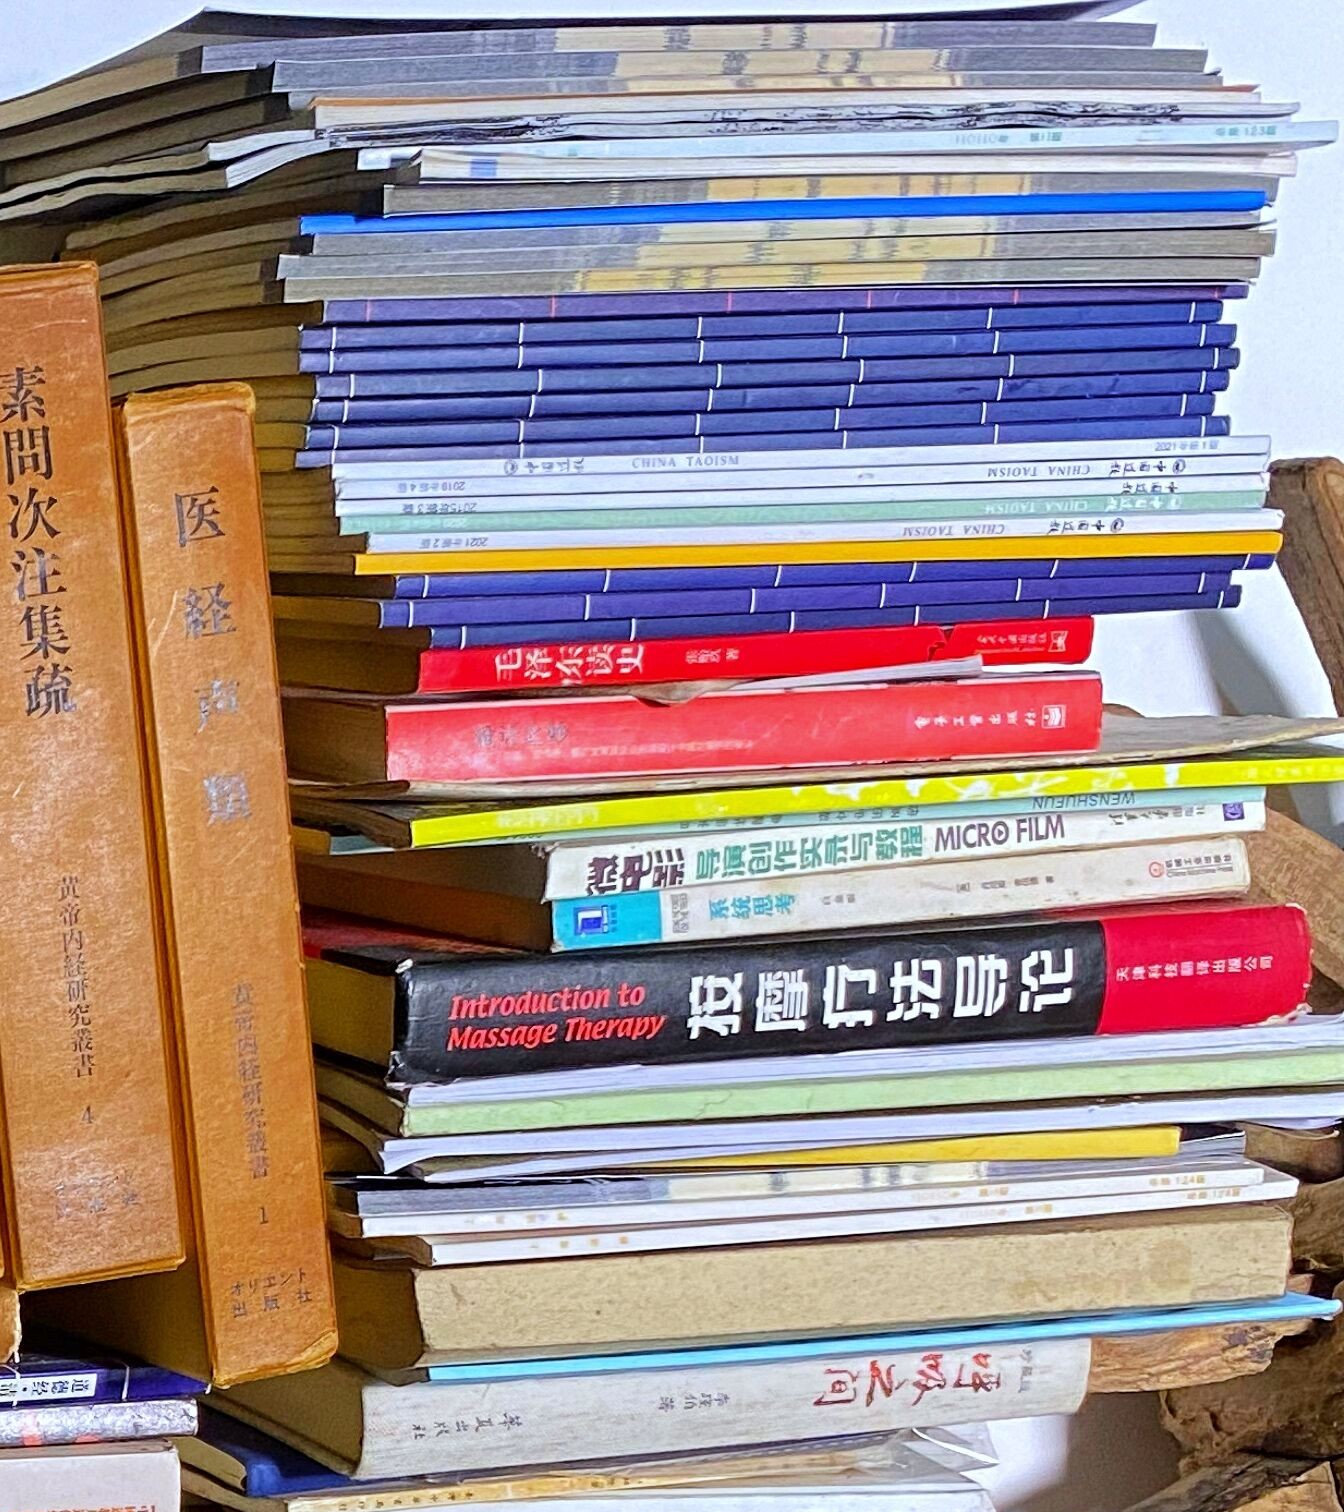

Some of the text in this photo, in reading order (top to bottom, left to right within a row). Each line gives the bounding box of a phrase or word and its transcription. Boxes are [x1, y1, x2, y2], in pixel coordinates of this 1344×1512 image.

[935, 824, 1007, 850] MICRO
[1018, 814, 1064, 844] FILM
[709, 890, 796, 921] 系统思考
[449, 981, 644, 1019] Introduction to
[689, 948, 1076, 1040] 按摩疗法导论
[447, 1013, 667, 1053] Massage Therapy
